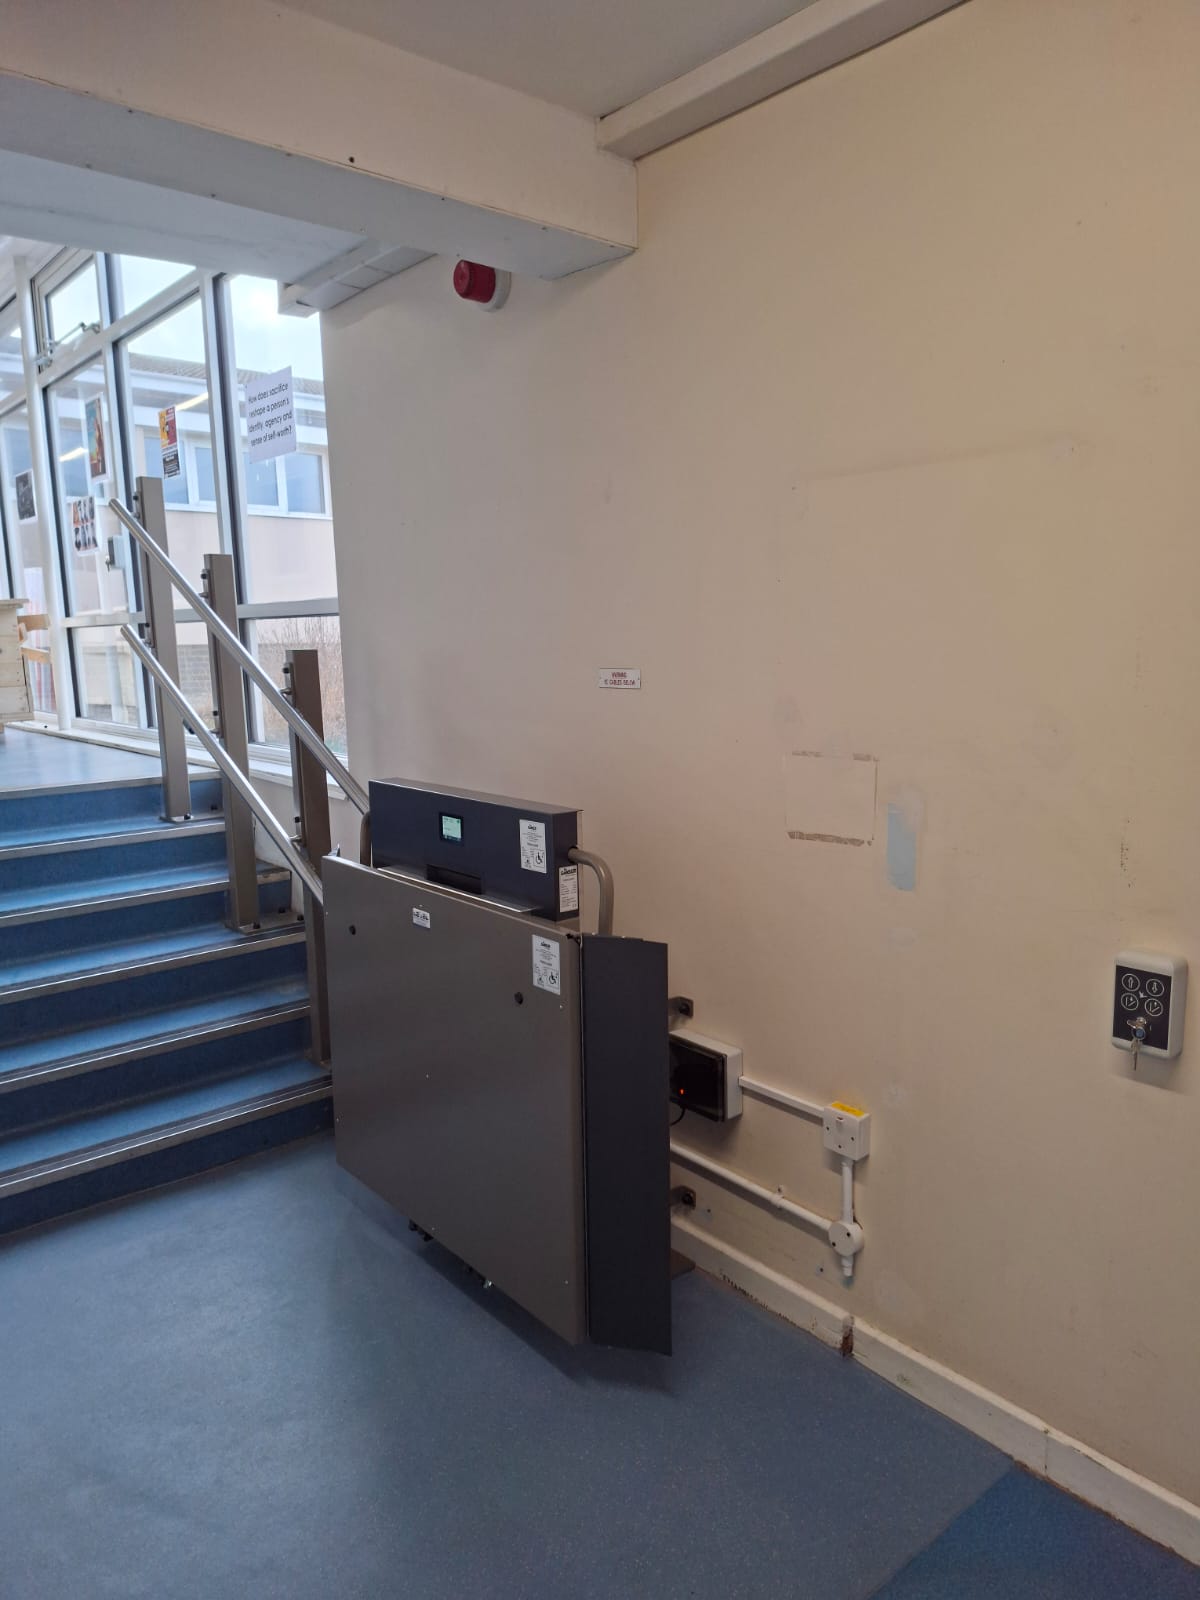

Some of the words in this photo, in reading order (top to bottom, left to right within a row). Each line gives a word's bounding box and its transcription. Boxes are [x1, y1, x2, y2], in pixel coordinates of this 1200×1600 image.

[258, 391, 268, 400] does
[269, 383, 288, 396] sacrifice
[265, 415, 282, 428] agency
[283, 410, 293, 421] and
